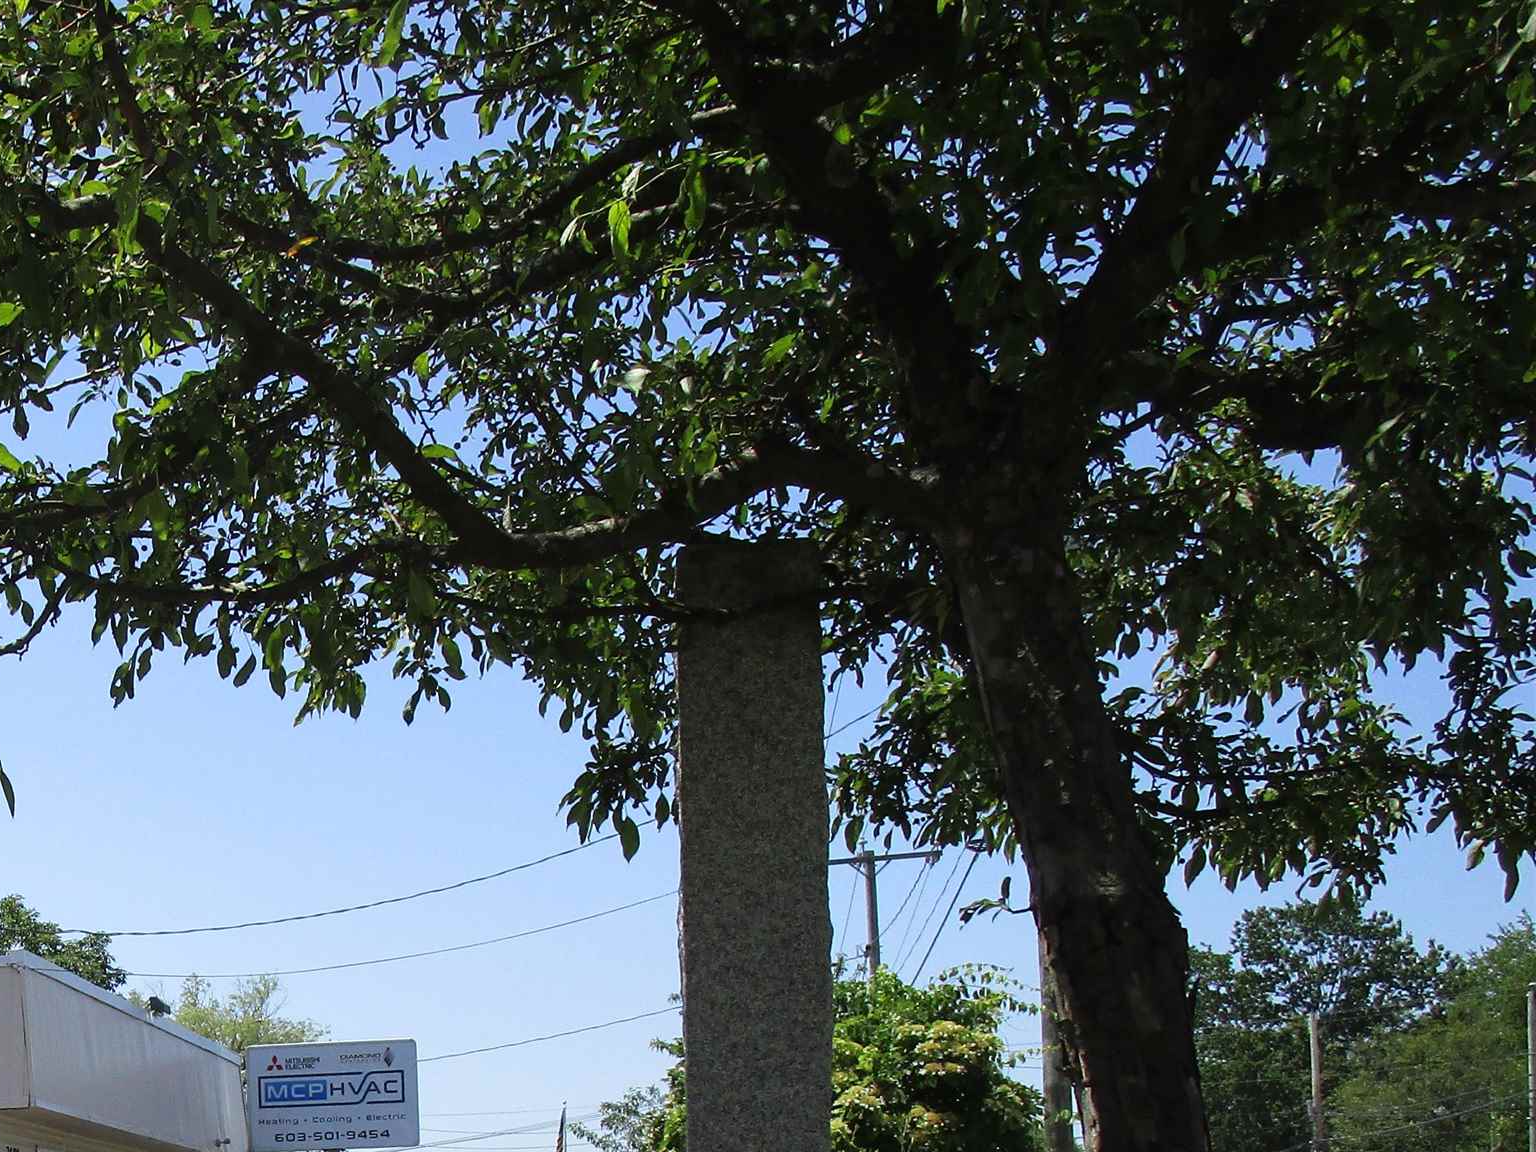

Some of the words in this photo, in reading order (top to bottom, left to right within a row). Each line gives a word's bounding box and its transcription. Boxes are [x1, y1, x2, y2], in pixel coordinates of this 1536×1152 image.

[267, 1083, 325, 1099] MCP
[330, 1080, 398, 1096] HVAC
[258, 1117, 299, 1126] Heating
[312, 1115, 352, 1124] Cooling
[366, 1113, 407, 1121] Electric
[275, 1130, 391, 1143] 603-501-9454
